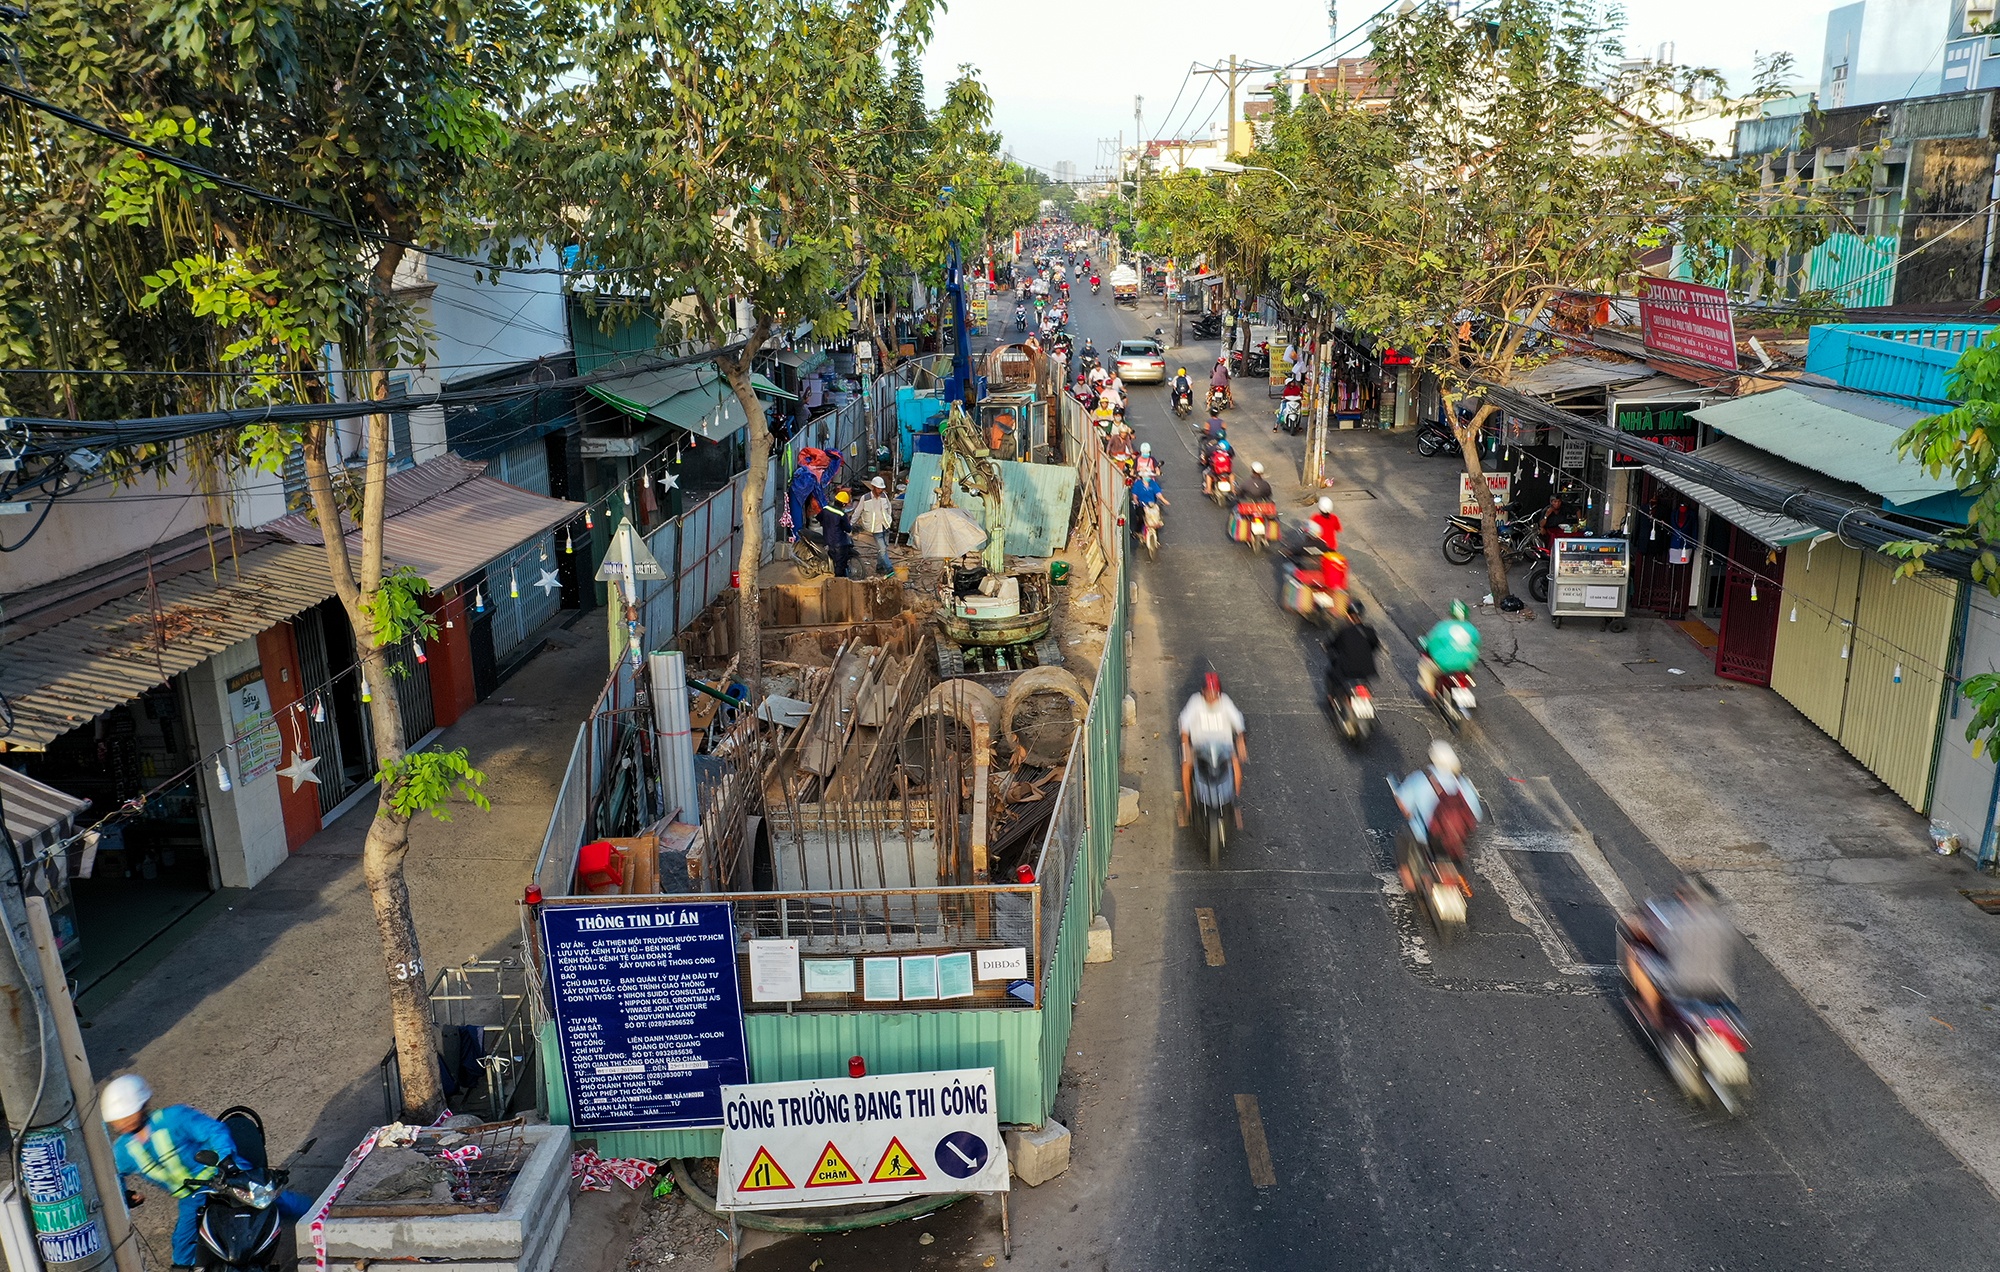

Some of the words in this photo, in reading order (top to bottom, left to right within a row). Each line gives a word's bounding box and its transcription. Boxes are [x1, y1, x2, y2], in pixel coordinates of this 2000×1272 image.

[1648, 285, 1688, 314] PHONG
[1620, 406, 1653, 430] NHÀ
[576, 913, 624, 930] THÔNG
[627, 914, 651, 928] TIN
[655, 910, 676, 928] DỰ
[680, 909, 699, 926] ÁN
[727, 1093, 775, 1130] CÔNG
[778, 1087, 850, 1127] TRƯỜNG
[854, 1089, 902, 1122] ĐANG
[906, 1088, 936, 1118] THI
[940, 1078, 988, 1117] CÔNG
[827, 1158, 838, 1168] ĐI
[818, 1170, 848, 1181] CHẬM
